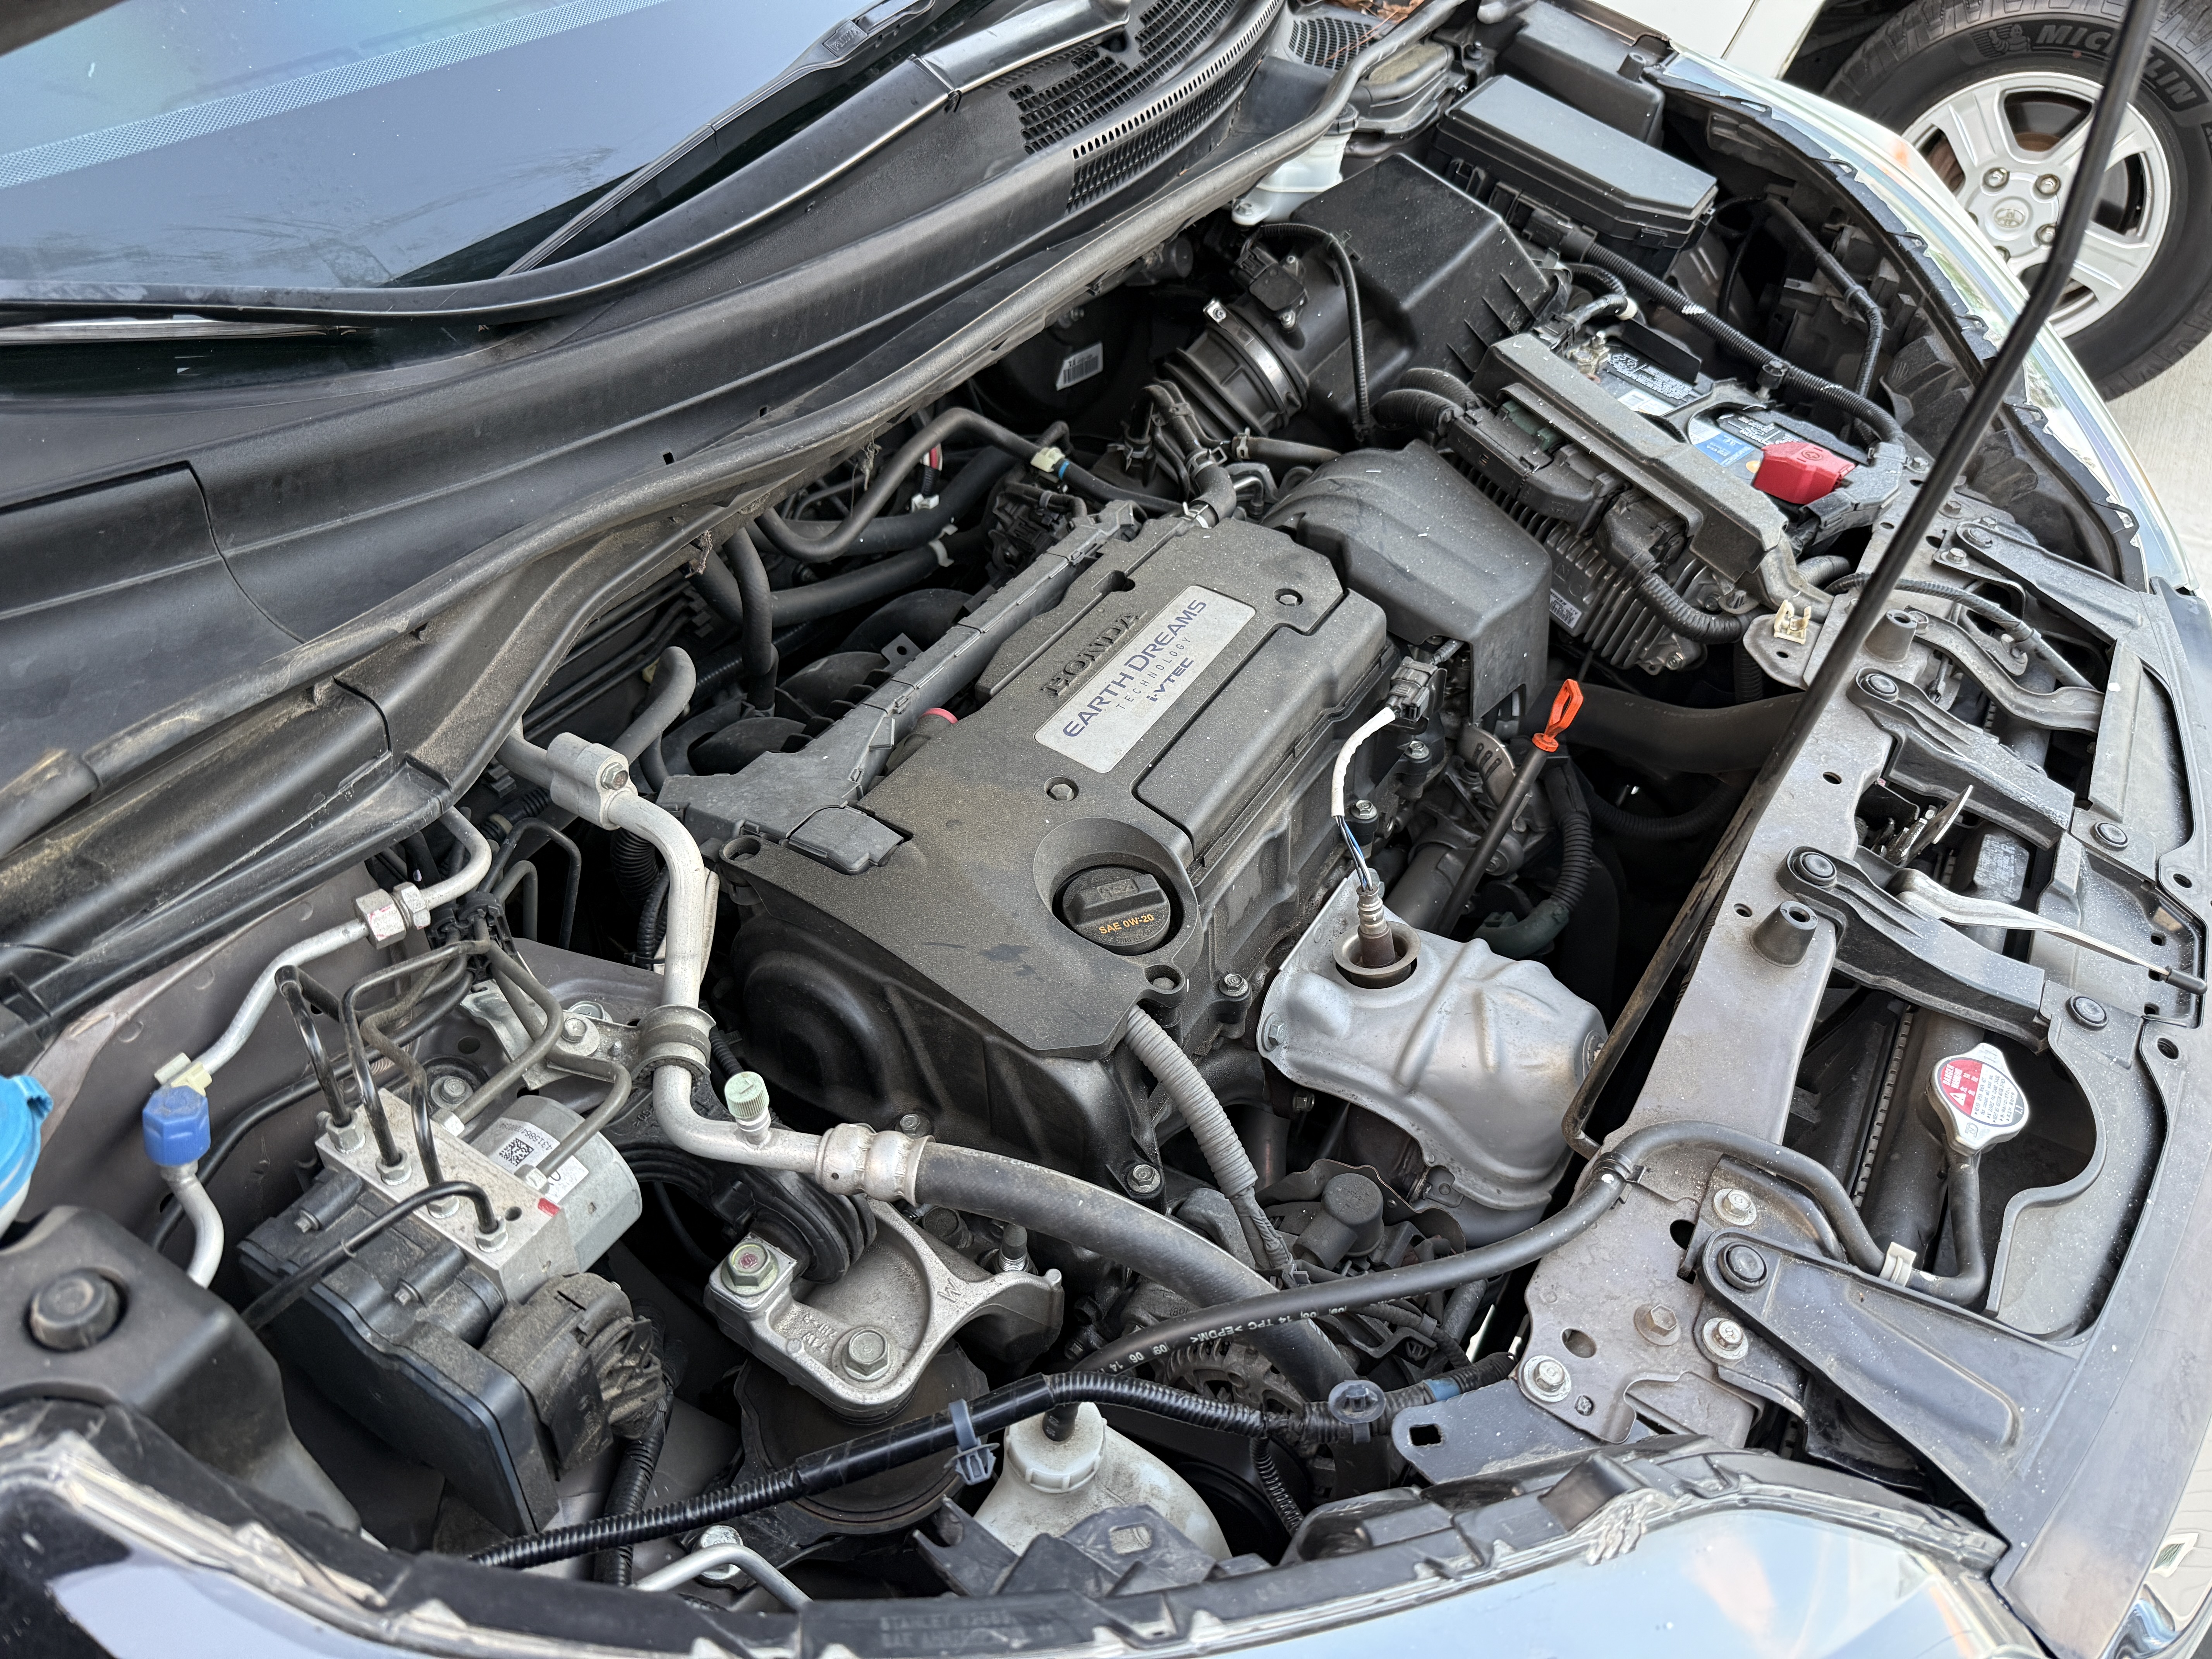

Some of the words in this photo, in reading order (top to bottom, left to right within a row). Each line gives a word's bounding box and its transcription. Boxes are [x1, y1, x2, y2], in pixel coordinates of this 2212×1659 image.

[2036, 24, 2196, 104] MICLIN
[1041, 611, 1147, 696] HONDA
[1116, 637, 1191, 710] TECHNOLOGY
[1147, 657, 1194, 702] i-VTEC
[1099, 922, 1122, 934] SAE
[1123, 914, 1154, 928] 0W-20
[1942, 1064, 1955, 1086] DANGER
[1190, 1326, 1244, 1343] >EPDM<
[1247, 1319, 1274, 1330] TPC
